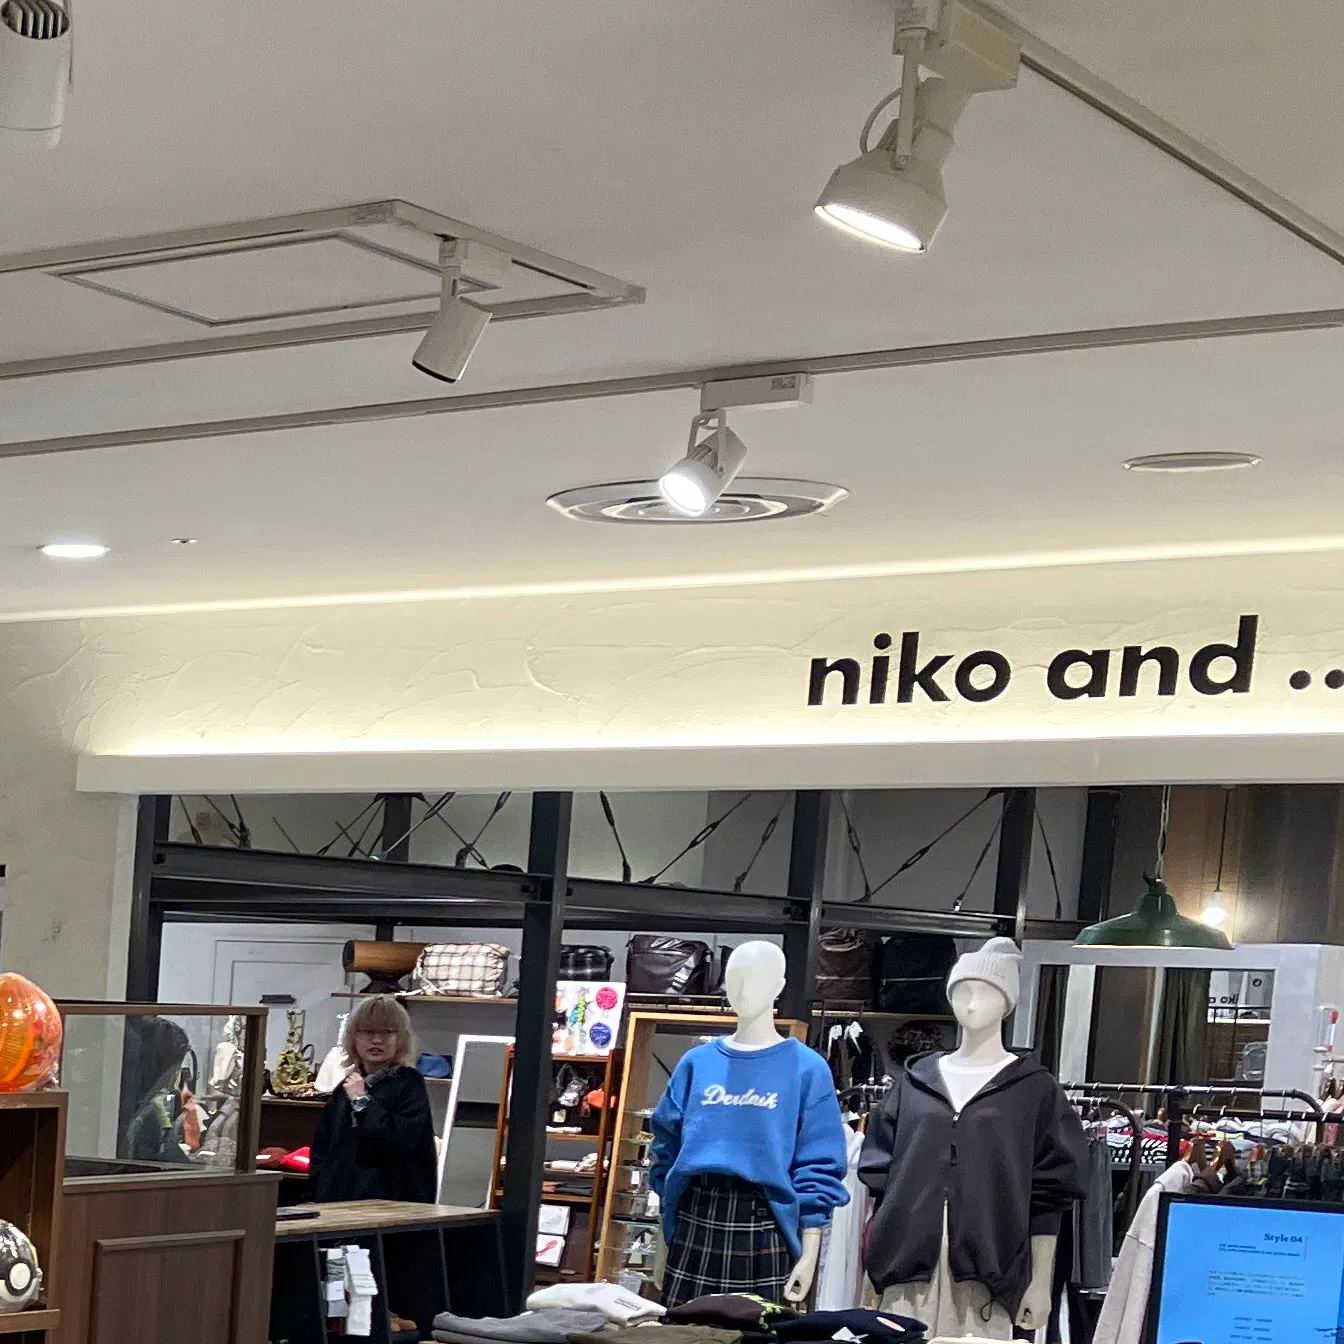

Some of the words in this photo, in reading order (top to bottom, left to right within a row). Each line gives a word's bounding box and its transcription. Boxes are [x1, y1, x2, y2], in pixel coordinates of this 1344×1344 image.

[807, 631, 1012, 706] niko
[1046, 615, 1259, 701] and
[1264, 1232, 1289, 1244] Style
[1290, 1235, 1303, 1243] 04
